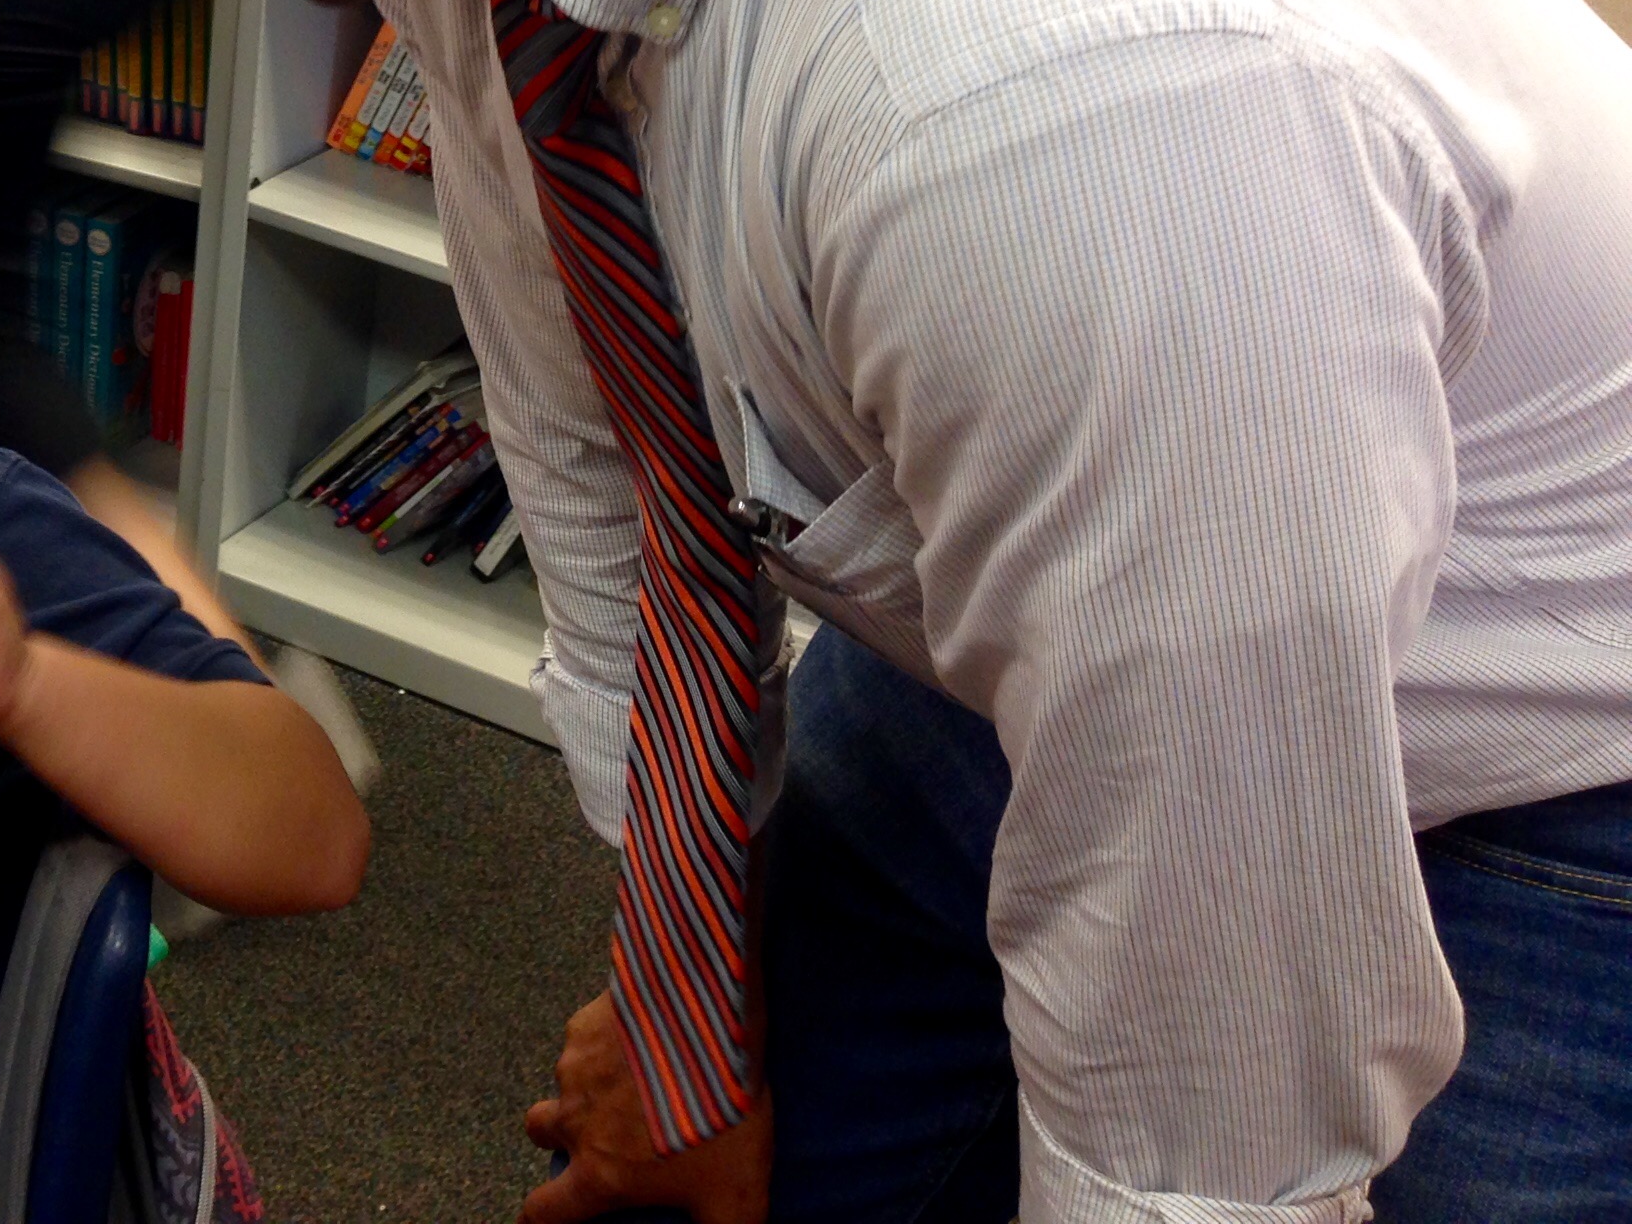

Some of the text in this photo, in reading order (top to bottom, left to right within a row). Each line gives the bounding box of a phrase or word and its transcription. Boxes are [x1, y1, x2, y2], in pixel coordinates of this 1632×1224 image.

[58, 251, 73, 328] Elementary
[86, 259, 105, 410] Elementary Dictionar
